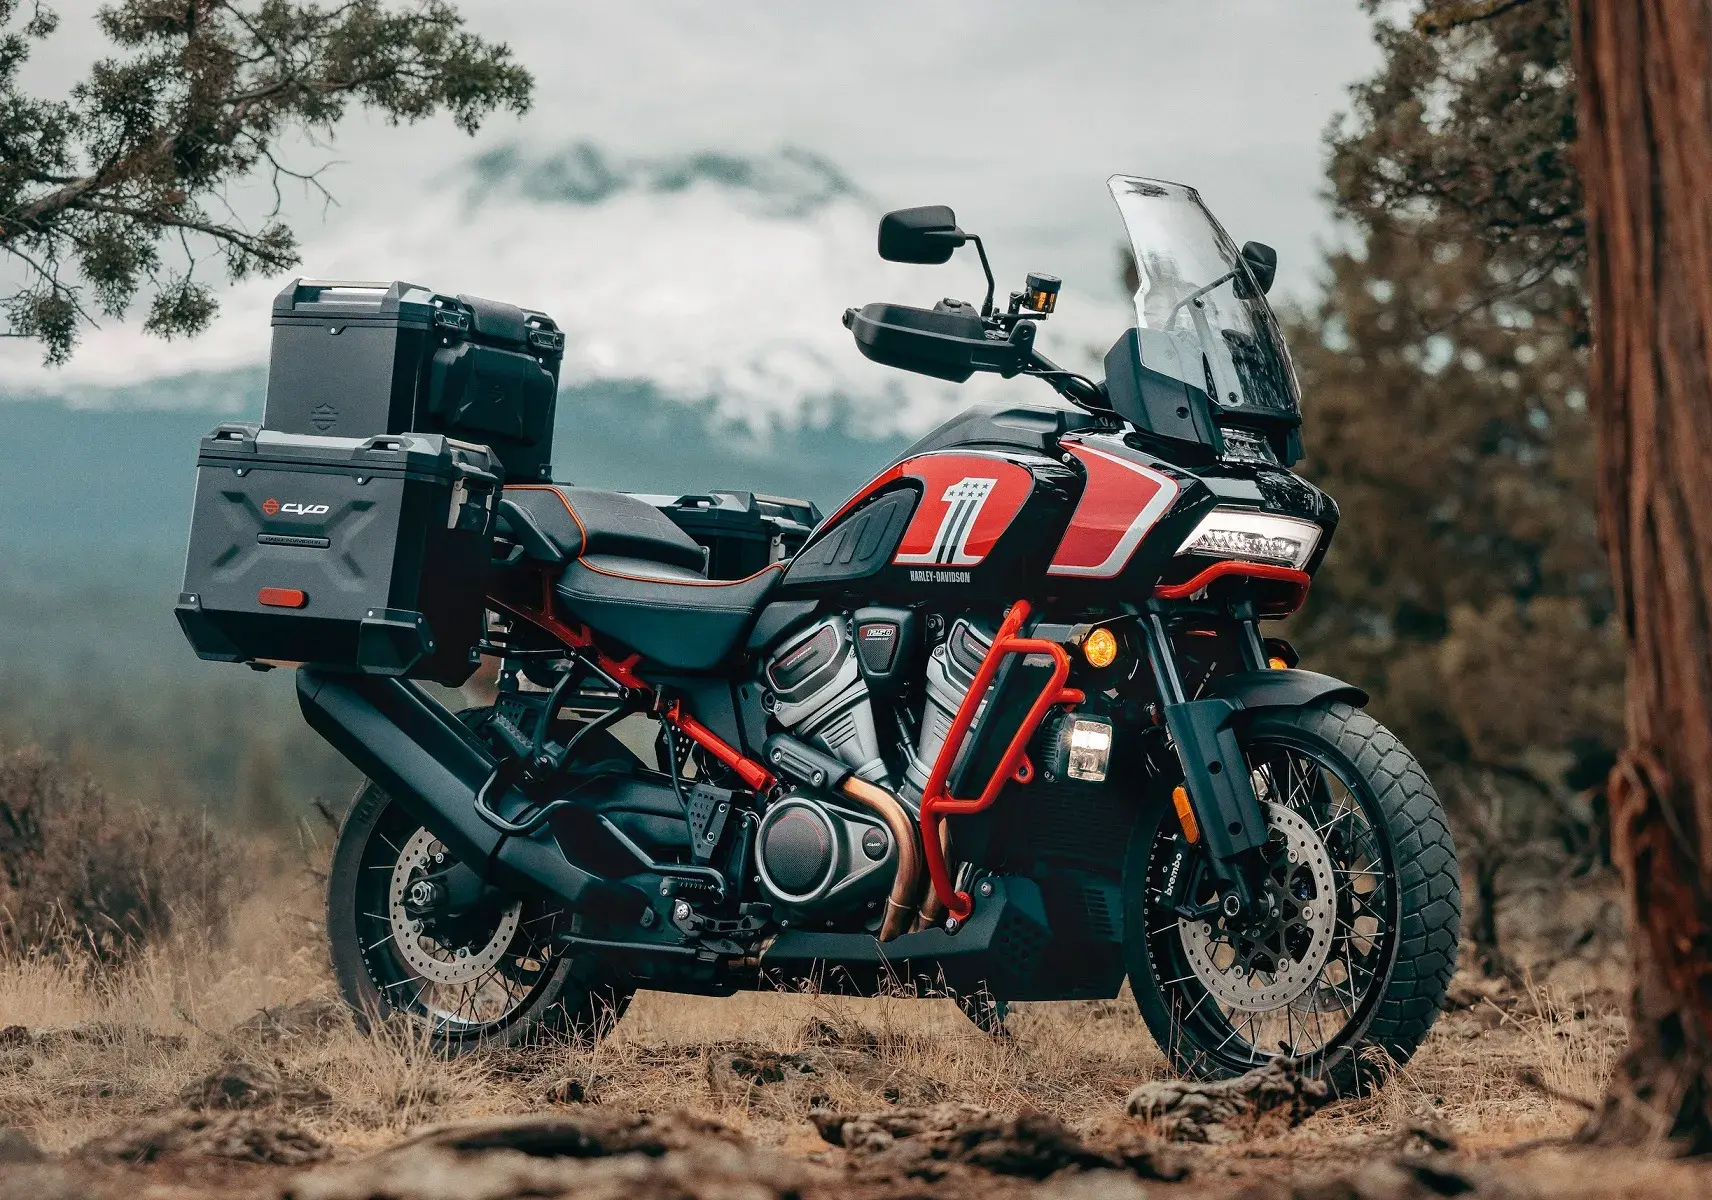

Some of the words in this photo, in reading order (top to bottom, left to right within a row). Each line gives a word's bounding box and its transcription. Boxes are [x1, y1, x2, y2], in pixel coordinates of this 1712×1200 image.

[281, 503, 330, 515] CVO
[894, 477, 998, 564] 1
[909, 570, 972, 583] HARLEY-DAVIDSON
[1163, 852, 1183, 897] brembo
